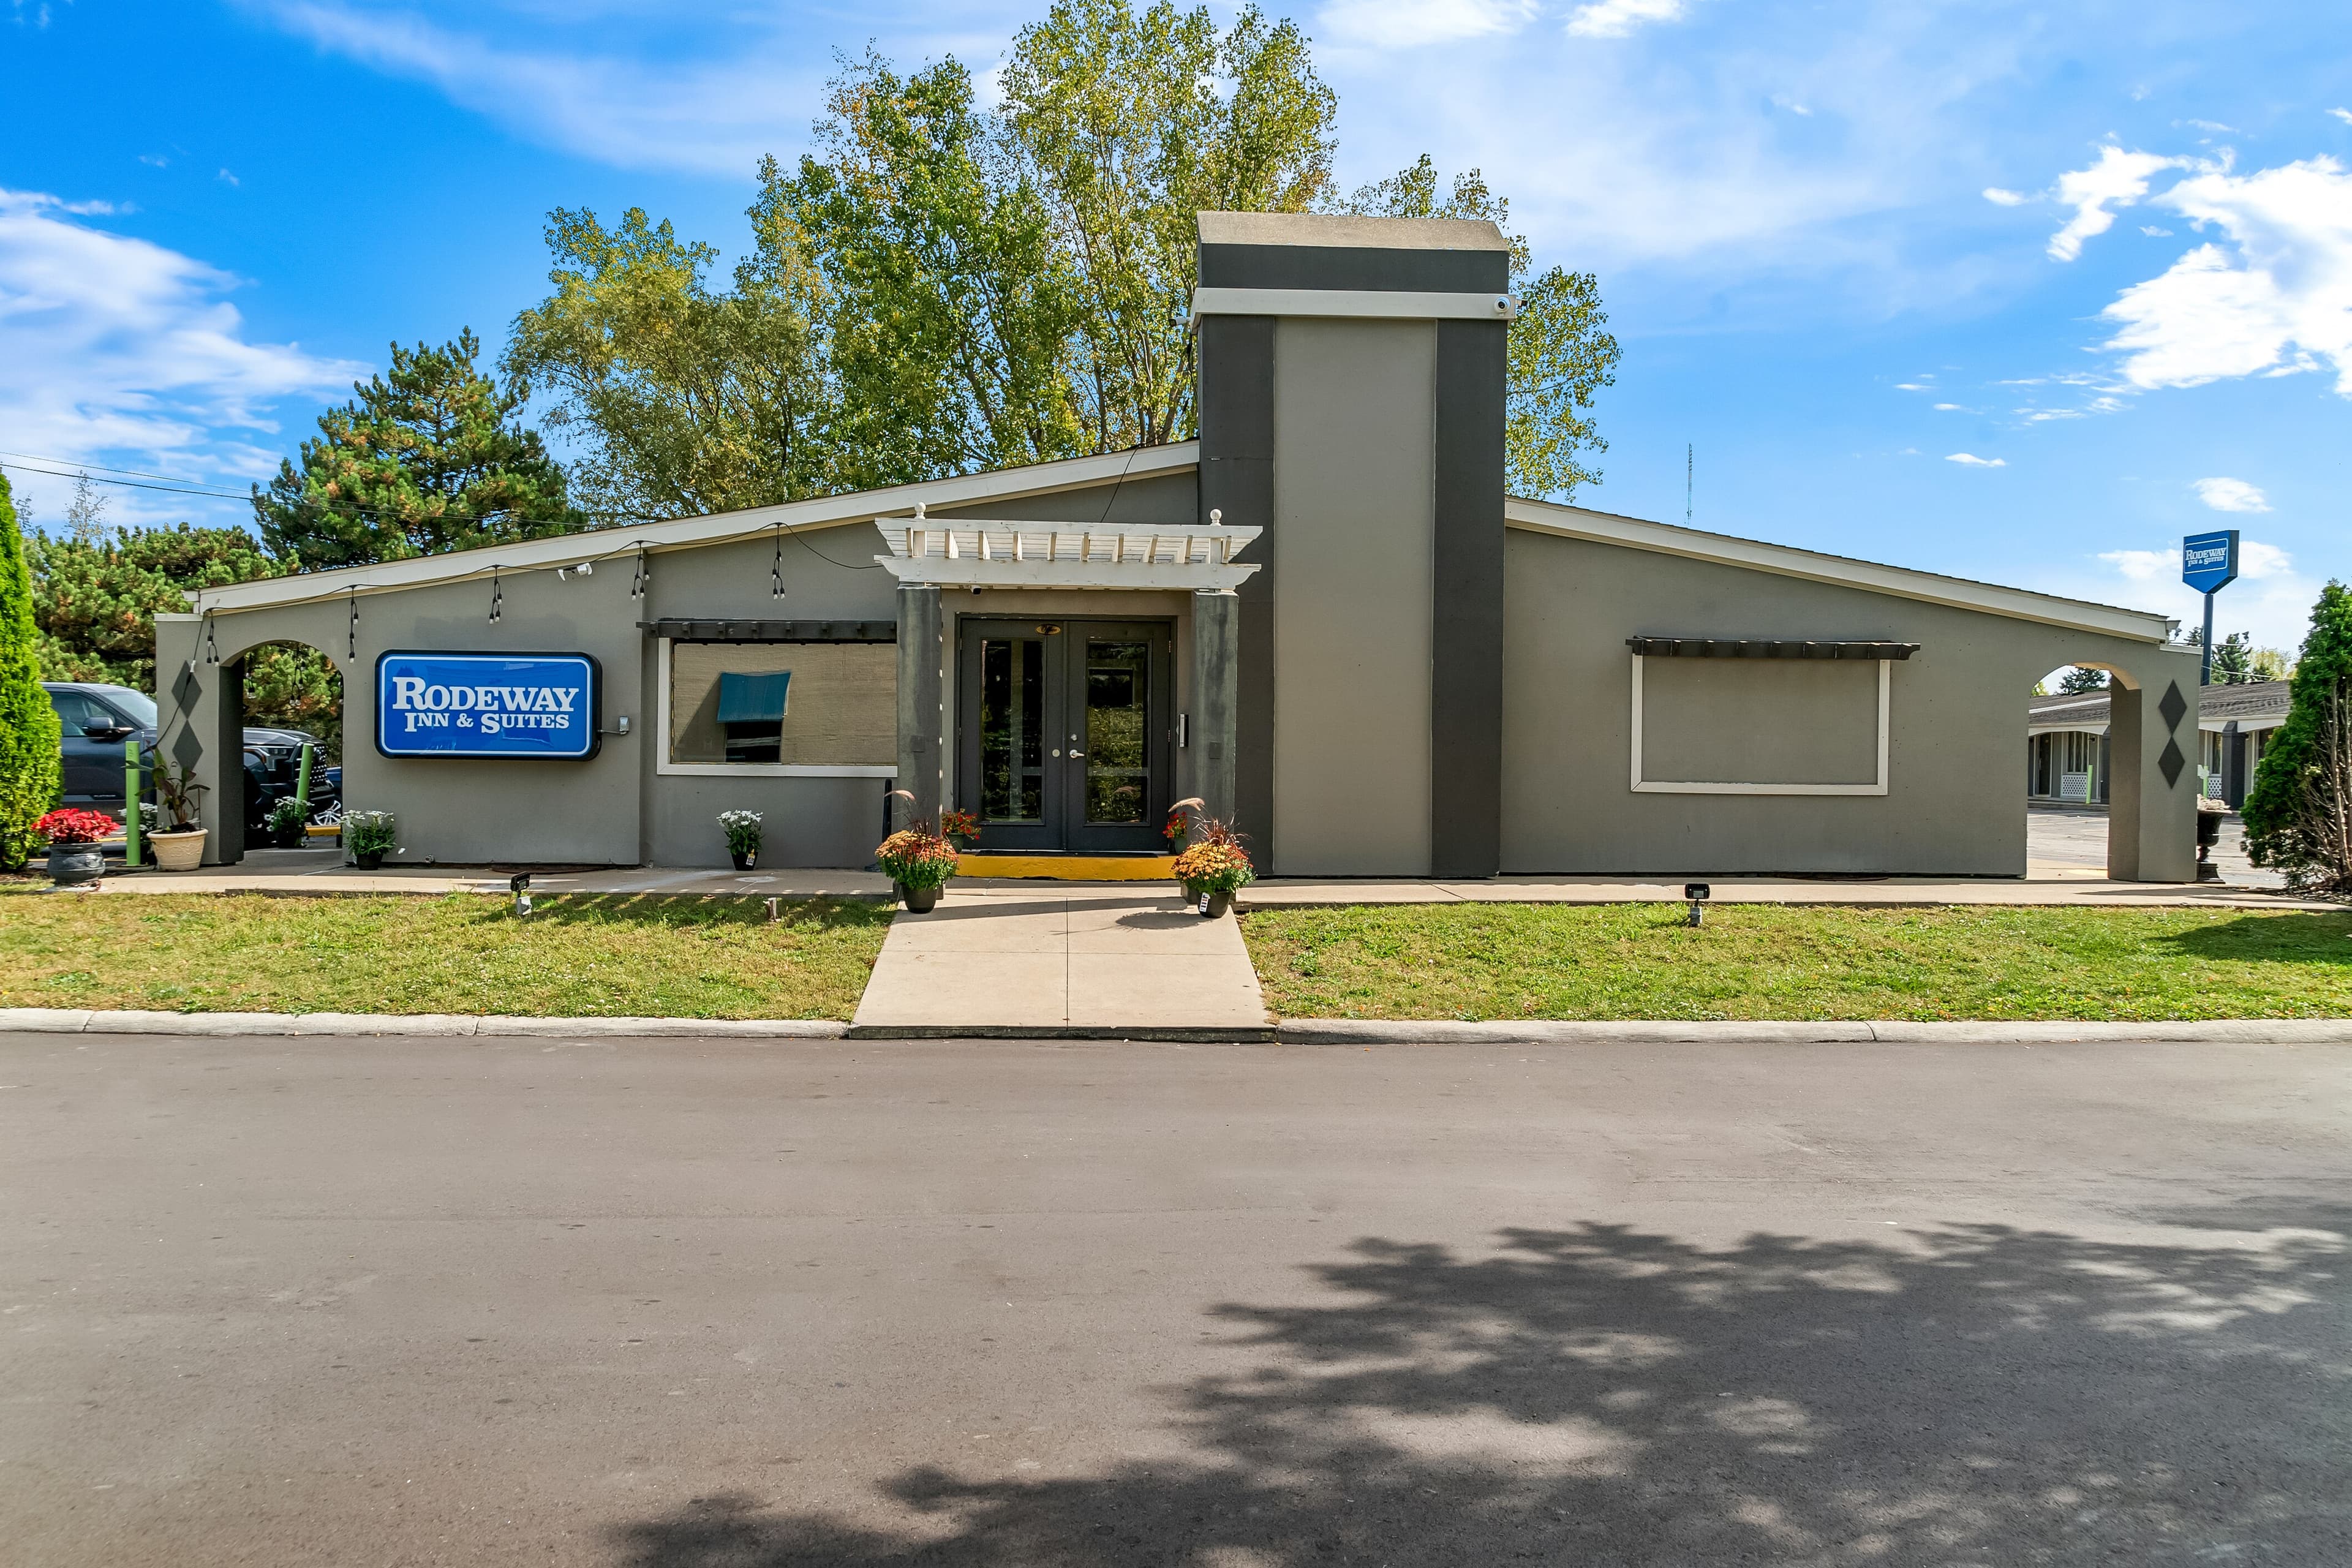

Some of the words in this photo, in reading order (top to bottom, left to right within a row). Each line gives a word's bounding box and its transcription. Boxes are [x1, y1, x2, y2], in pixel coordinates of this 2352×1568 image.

[2185, 548, 2226, 560] RODEWAY
[392, 677, 579, 712] RODEWAY
[405, 712, 450, 732] INN
[456, 713, 473, 728] &
[481, 713, 570, 734] SUITES
